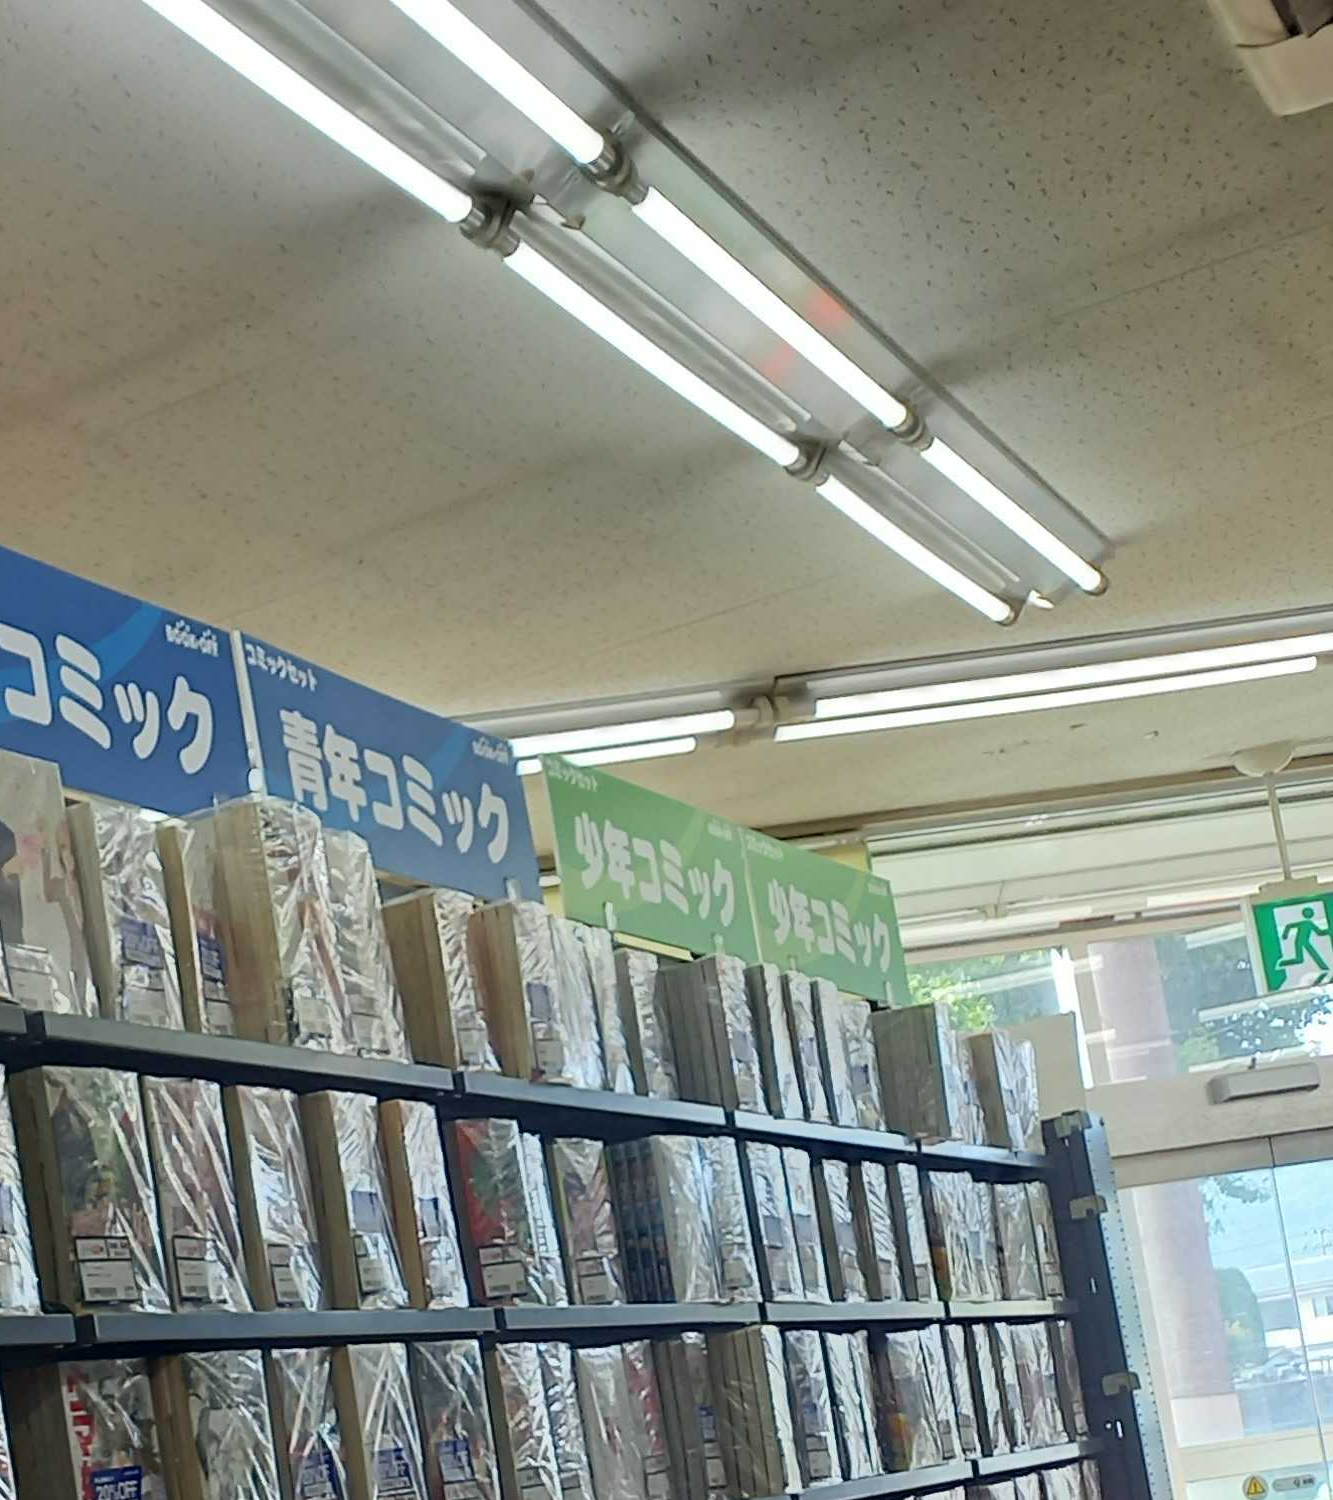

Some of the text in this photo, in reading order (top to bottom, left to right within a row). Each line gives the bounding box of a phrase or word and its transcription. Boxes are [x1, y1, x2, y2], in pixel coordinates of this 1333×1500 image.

[244, 642, 318, 692] コミックセット
[280, 708, 511, 865] 青年コミック
[574, 811, 733, 928] 少年コミック
[768, 877, 891, 973] 少年コミック
